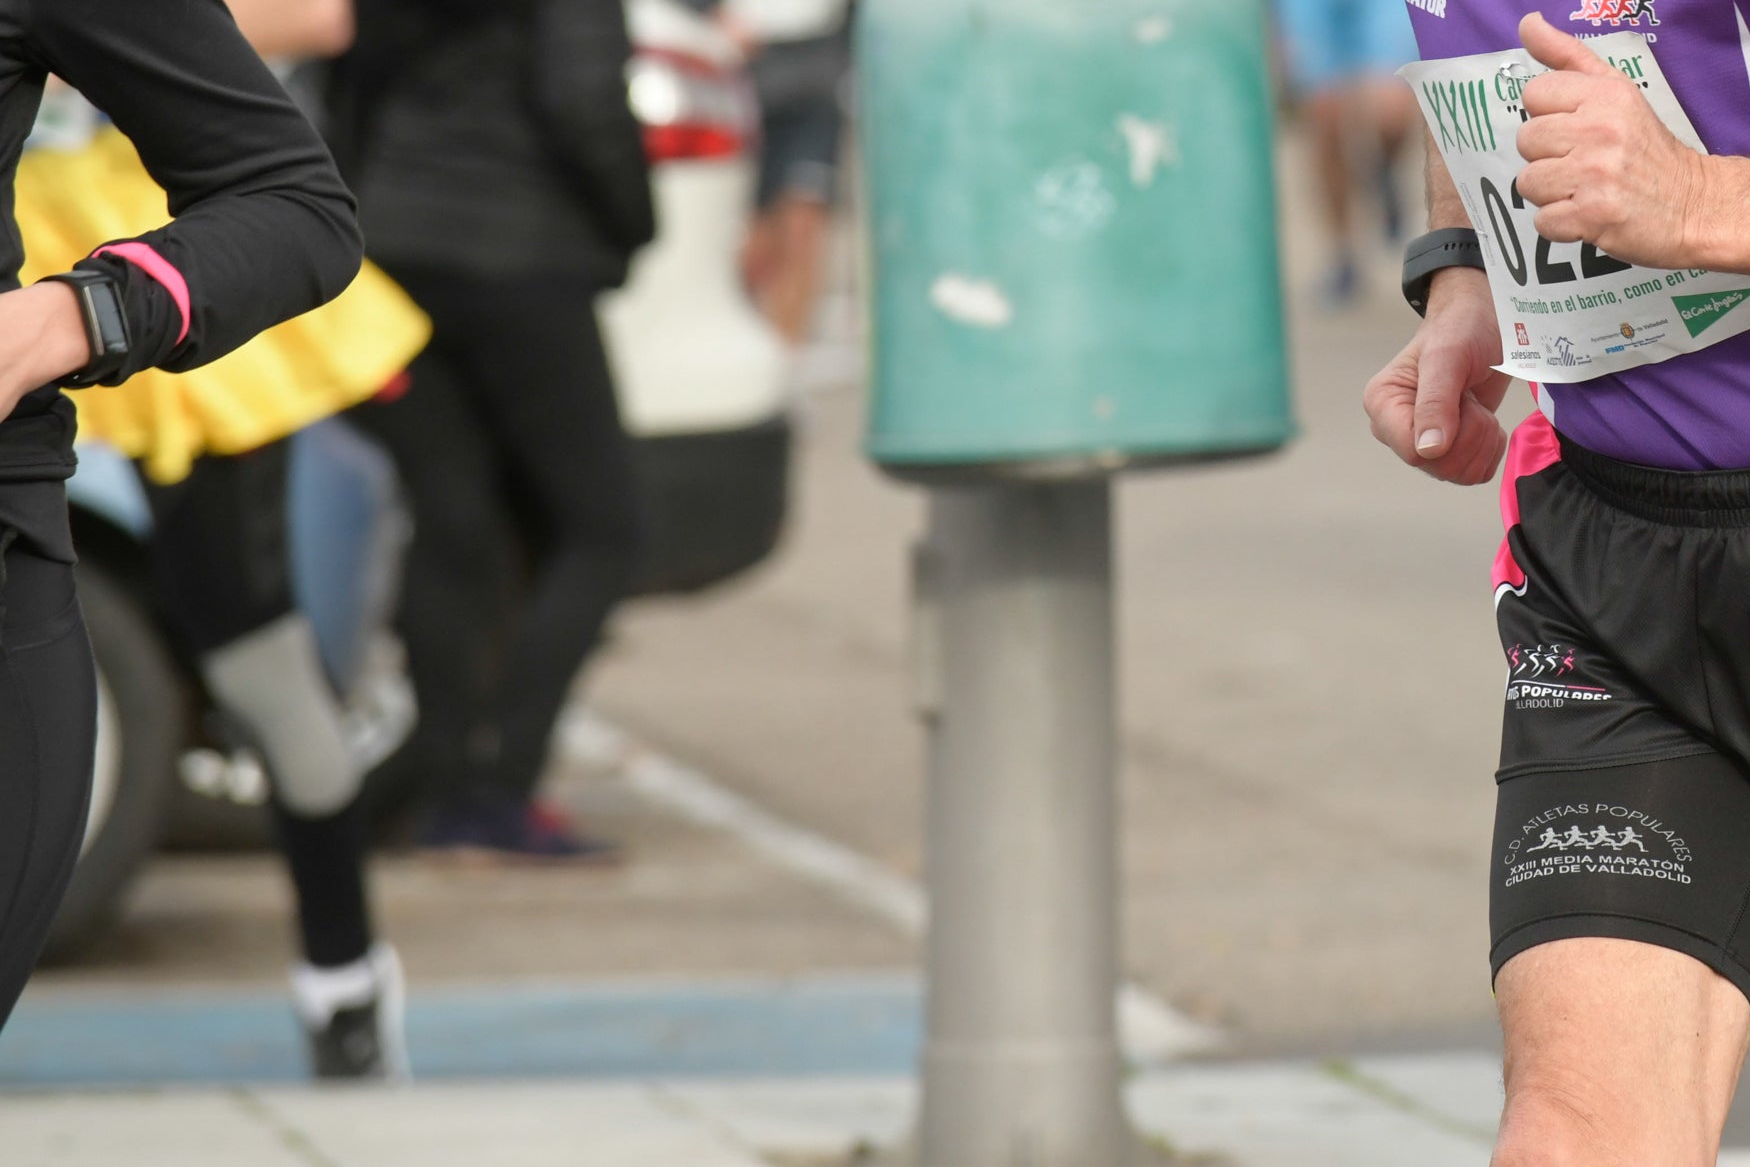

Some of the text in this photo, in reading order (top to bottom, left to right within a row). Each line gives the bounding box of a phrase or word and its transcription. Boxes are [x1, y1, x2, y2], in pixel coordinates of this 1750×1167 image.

[1422, 79, 1497, 154] XXIII
[1551, 300, 1563, 314] en
[1565, 295, 1577, 312] el
[1577, 289, 1622, 310] barrio,
[1623, 279, 1662, 299] como
[1665, 270, 1685, 287] en
[1510, 350, 1541, 360] salesianos
[1523, 804, 1589, 834] ATLETAS
[1595, 804, 1693, 863] POPULARES
[1505, 865, 1691, 887] CIUDAD DE VALLADOLID
[1510, 855, 1684, 876] XXIII MEDIA MARATÓN
